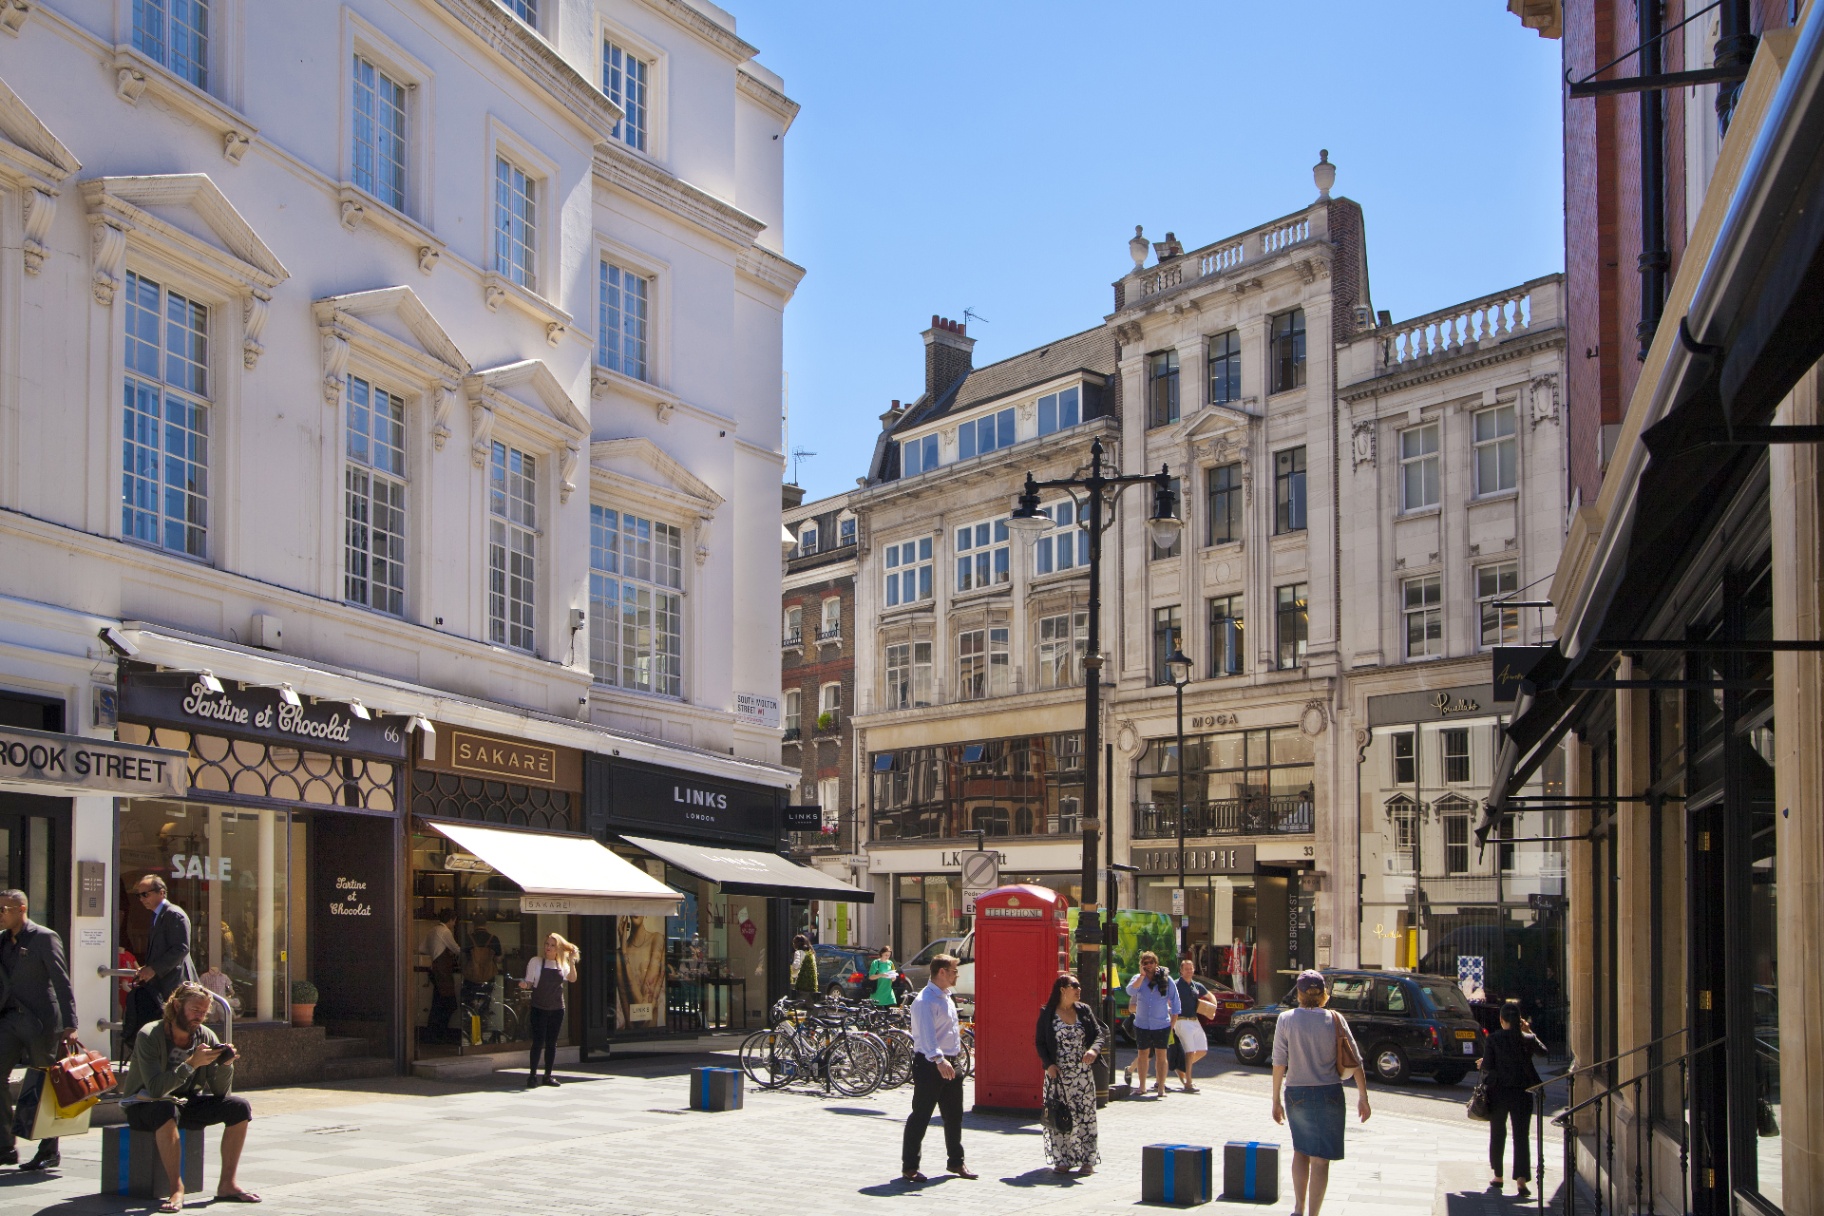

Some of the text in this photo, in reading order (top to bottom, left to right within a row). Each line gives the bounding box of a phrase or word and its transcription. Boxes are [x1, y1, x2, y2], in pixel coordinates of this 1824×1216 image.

[183, 682, 350, 742] Tartine et Chocolat
[384, 725, 399, 743] 66
[75, 750, 167, 783] STREET
[460, 743, 549, 772] SAKARÉ
[673, 786, 727, 809] LINKS
[685, 812, 715, 822] LONDON
[1145, 850, 1237, 870] APOSTROPHE
[1303, 846, 1314, 857] 33
[171, 853, 232, 881] SALE
[336, 877, 366, 889] Tartine
[347, 891, 357, 901] et
[330, 902, 371, 916] Chocolat
[986, 908, 1042, 918] TELEPHONE
[1289, 894, 1297, 951] 33 BROOK ST
